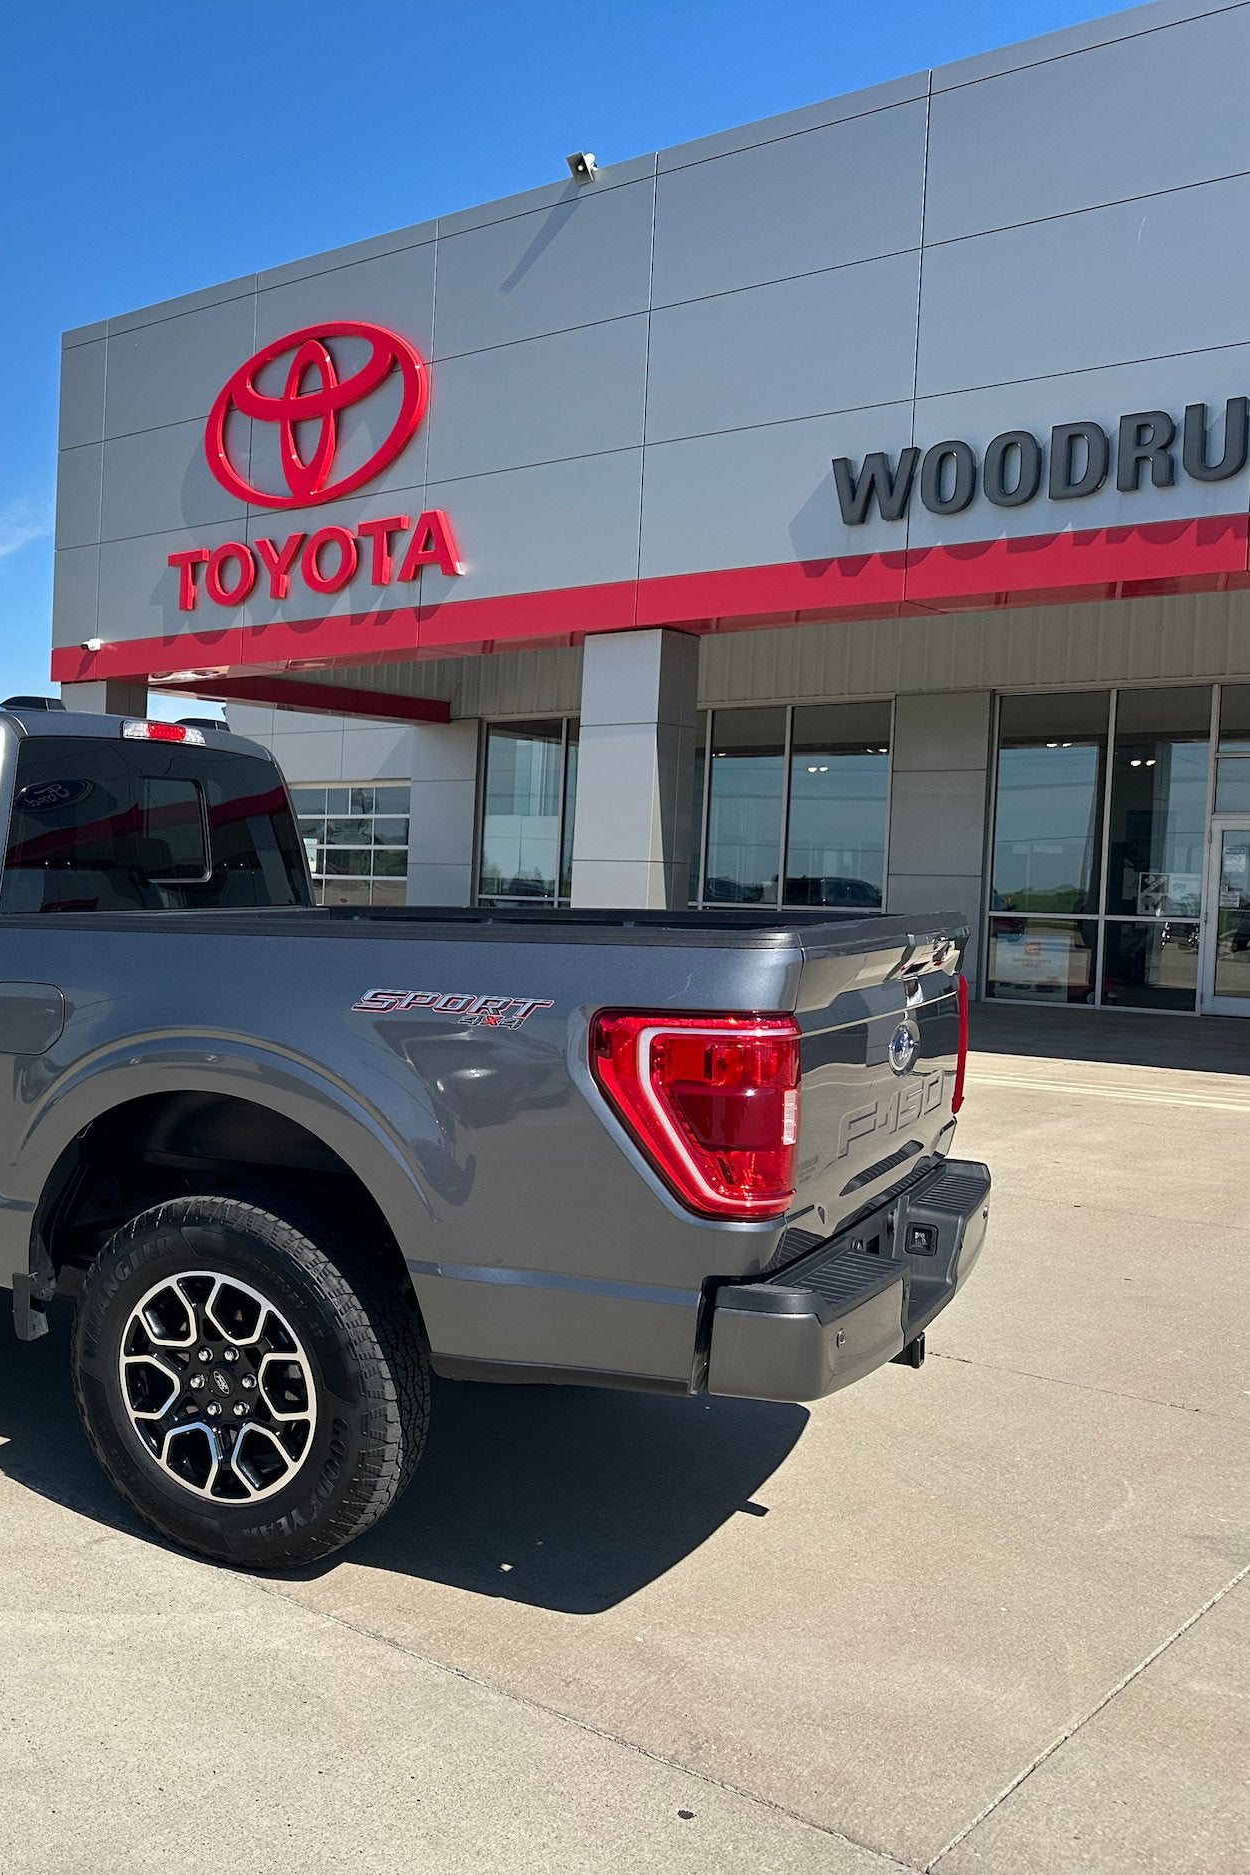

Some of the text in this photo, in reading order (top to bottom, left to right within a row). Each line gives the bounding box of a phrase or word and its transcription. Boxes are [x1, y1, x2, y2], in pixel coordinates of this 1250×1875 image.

[831, 396, 1249, 526] WOODRU
[167, 509, 464, 611] TOYOTA
[350, 988, 555, 1019] SPORT
[837, 1069, 944, 1160] F-150
